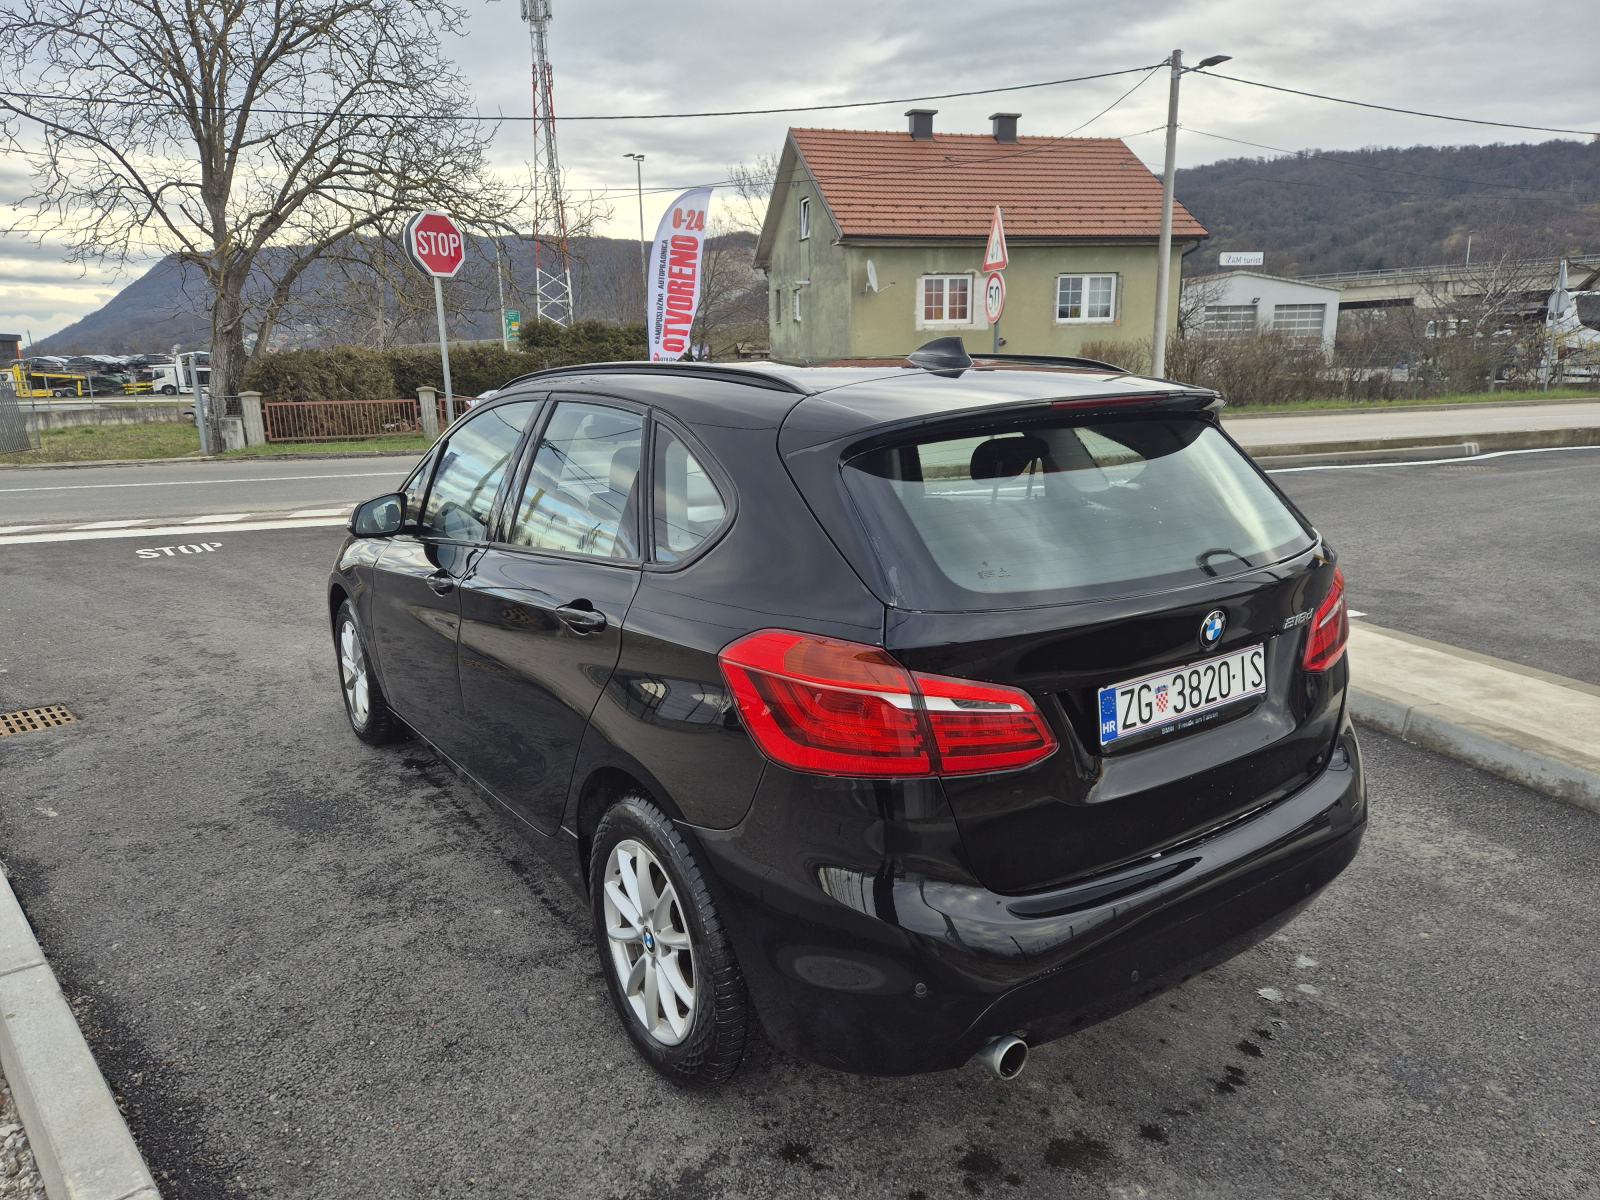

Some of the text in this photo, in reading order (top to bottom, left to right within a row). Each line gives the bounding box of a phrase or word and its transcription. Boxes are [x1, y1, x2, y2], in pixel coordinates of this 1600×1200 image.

[672, 208, 705, 231] 0-24
[417, 230, 460, 257] STOP
[662, 234, 699, 353] OTVORENO
[988, 285, 1000, 310] 50
[135, 542, 223, 559] STOP
[1120, 683, 1153, 731] ZG
[1101, 719, 1116, 734] HR
